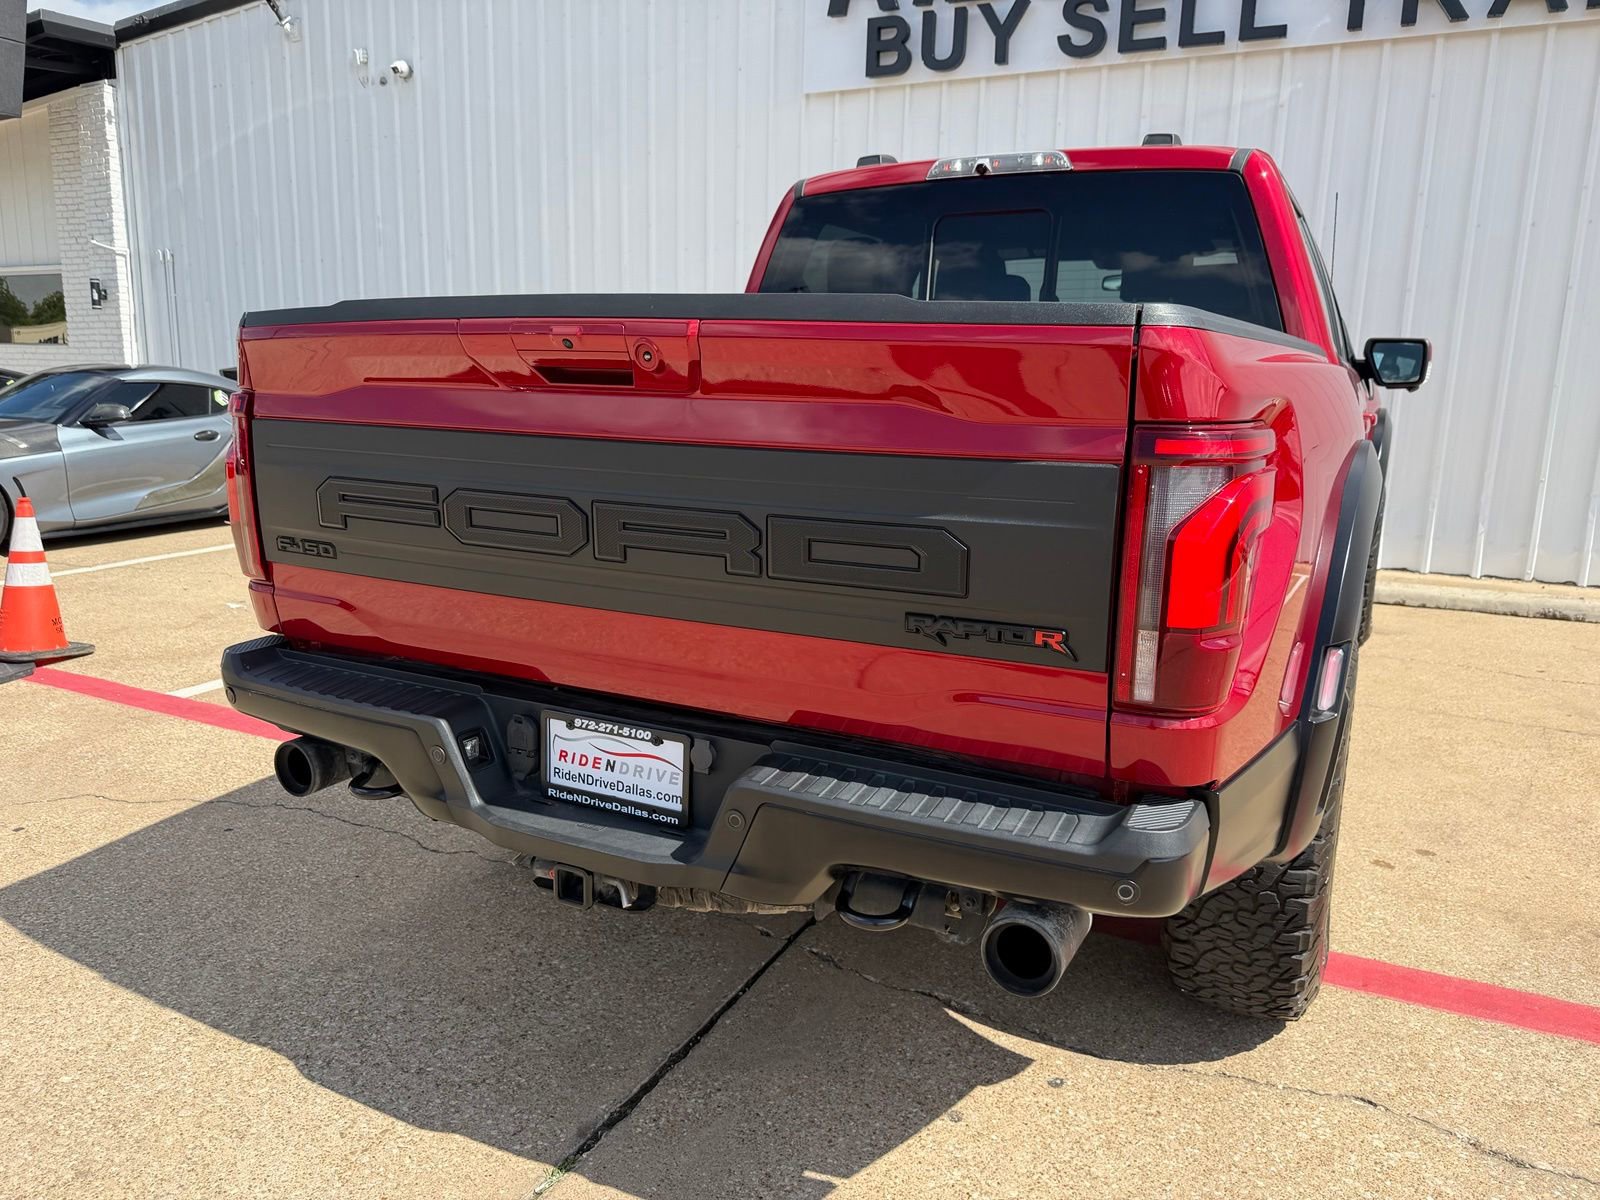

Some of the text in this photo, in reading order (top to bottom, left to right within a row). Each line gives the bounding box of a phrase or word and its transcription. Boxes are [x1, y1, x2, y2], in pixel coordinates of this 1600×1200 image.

[866, 0, 1031, 78] BUY
[1057, 0, 1288, 59] SELL
[276, 535, 338, 560] F-150
[316, 475, 969, 599] FORD
[904, 611, 1079, 663] RAPTOR
[574, 717, 652, 741] 972-271-5100
[553, 766, 682, 805] RideNDriveDallas.com
[547, 787, 679, 825] RideNDriveDallas.com
